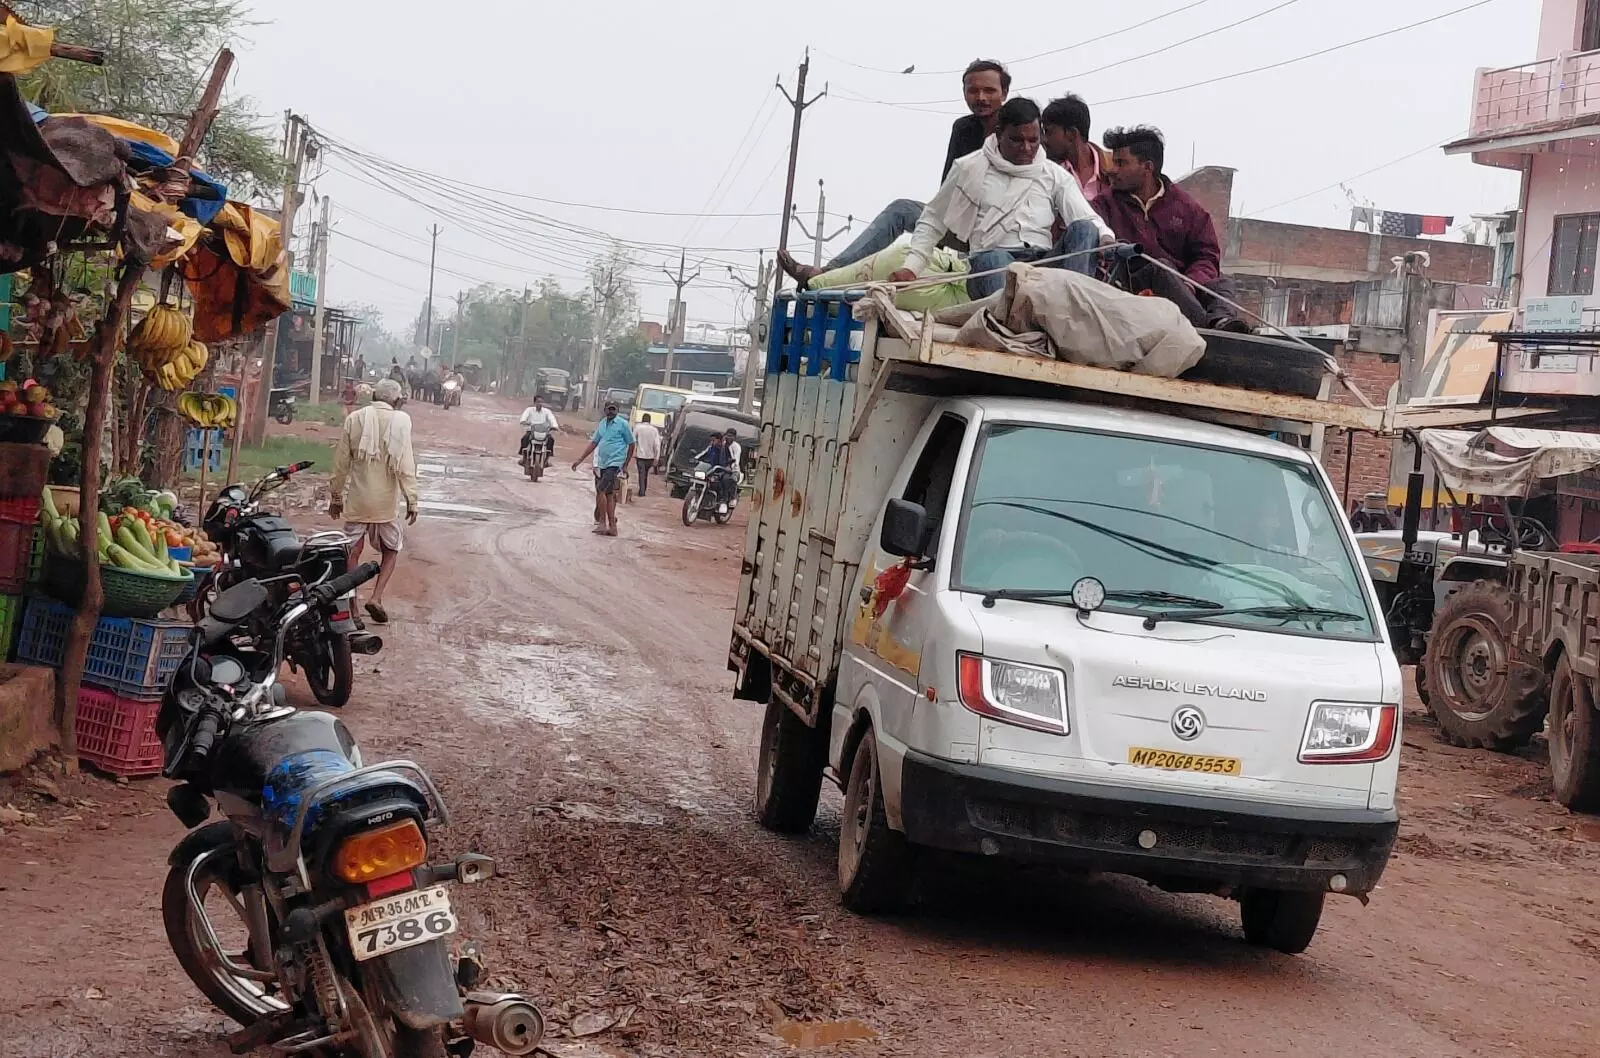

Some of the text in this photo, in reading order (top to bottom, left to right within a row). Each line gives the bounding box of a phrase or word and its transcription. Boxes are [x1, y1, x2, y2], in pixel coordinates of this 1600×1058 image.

[1112, 675, 1267, 702] ASHOK LEYLAND
[357, 911, 452, 953] 7386
